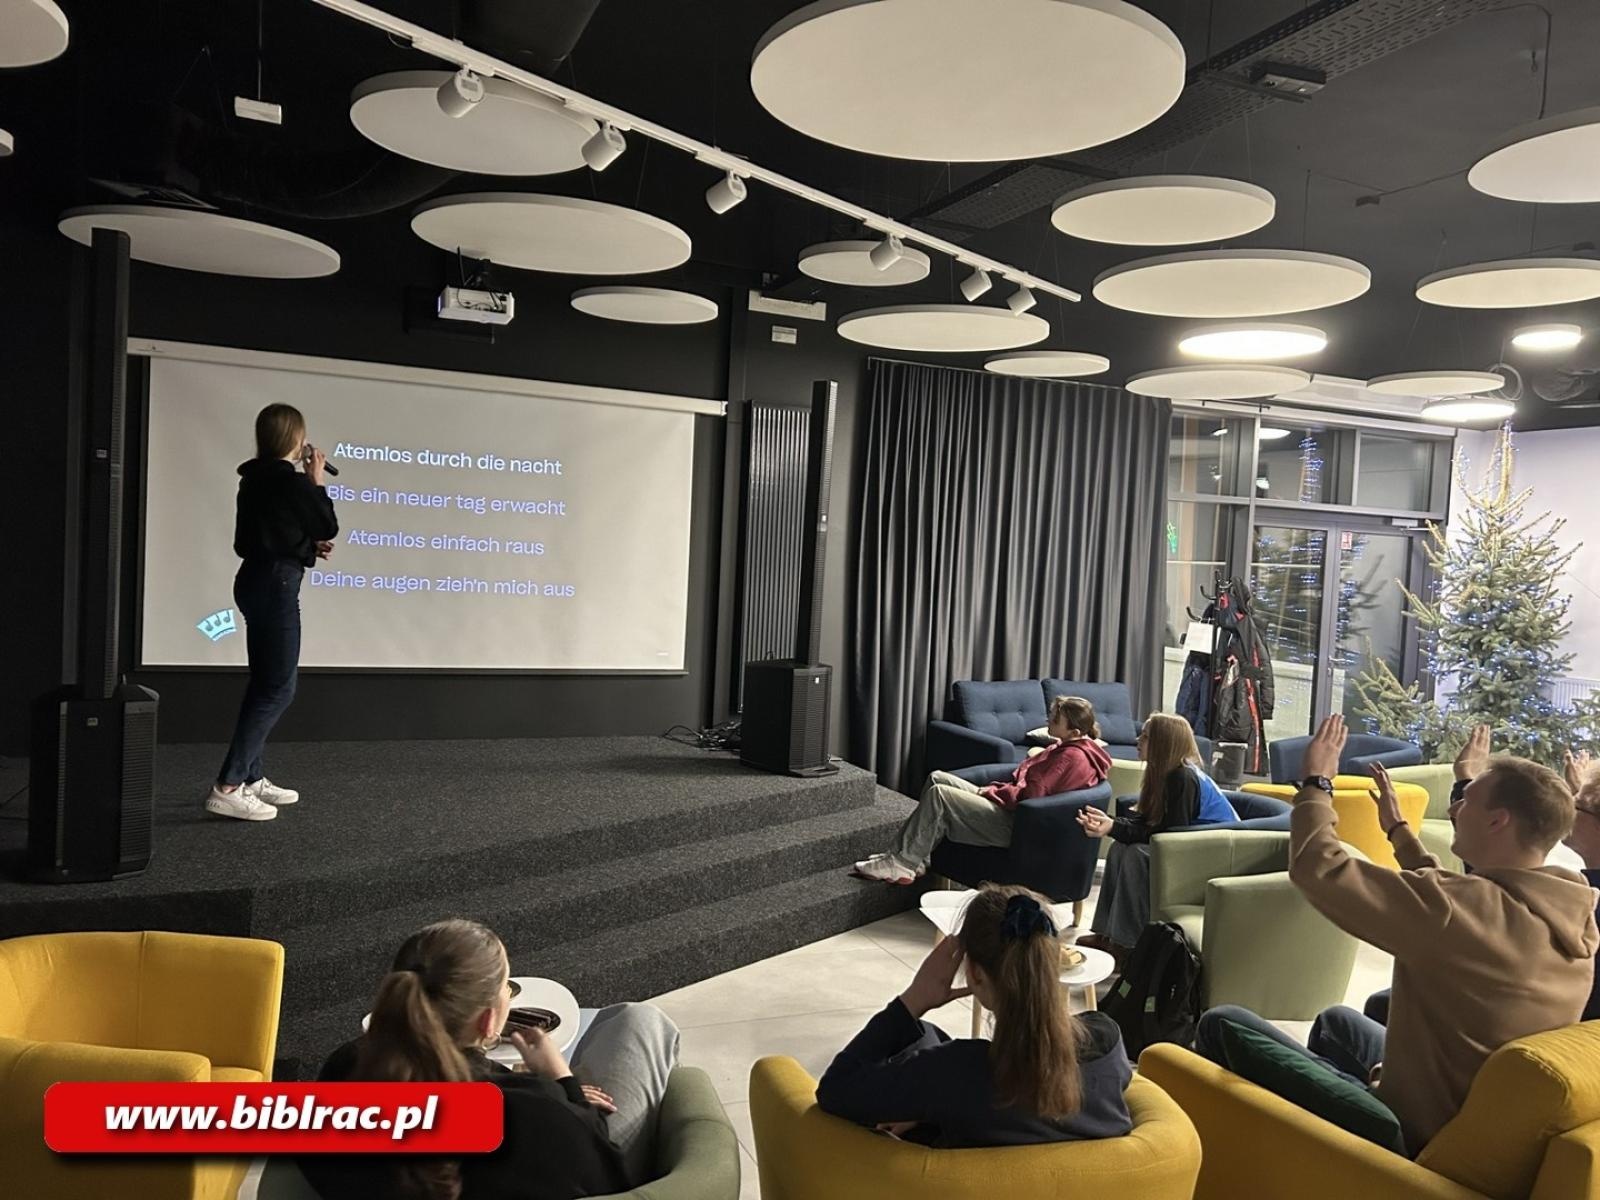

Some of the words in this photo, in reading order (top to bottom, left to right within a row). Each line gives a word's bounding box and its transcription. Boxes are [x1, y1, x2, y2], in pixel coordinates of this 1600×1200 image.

[334, 442, 412, 463] Atemlos
[417, 449, 472, 468] durch
[477, 454, 505, 471] die
[510, 459, 563, 475] nacht
[327, 485, 355, 501] Bis
[360, 487, 389, 504] ein
[395, 491, 452, 508] neuer
[455, 494, 486, 514] tag
[490, 500, 566, 515] erwacht
[347, 530, 425, 548] Atemlos
[430, 534, 500, 552] einfach
[505, 541, 545, 555] raus
[310, 571, 367, 587] Deine
[371, 575, 430, 594] augen
[435, 576, 488, 593] zieh'n
[494, 579, 538, 595] mich
[543, 583, 576, 597] aus
